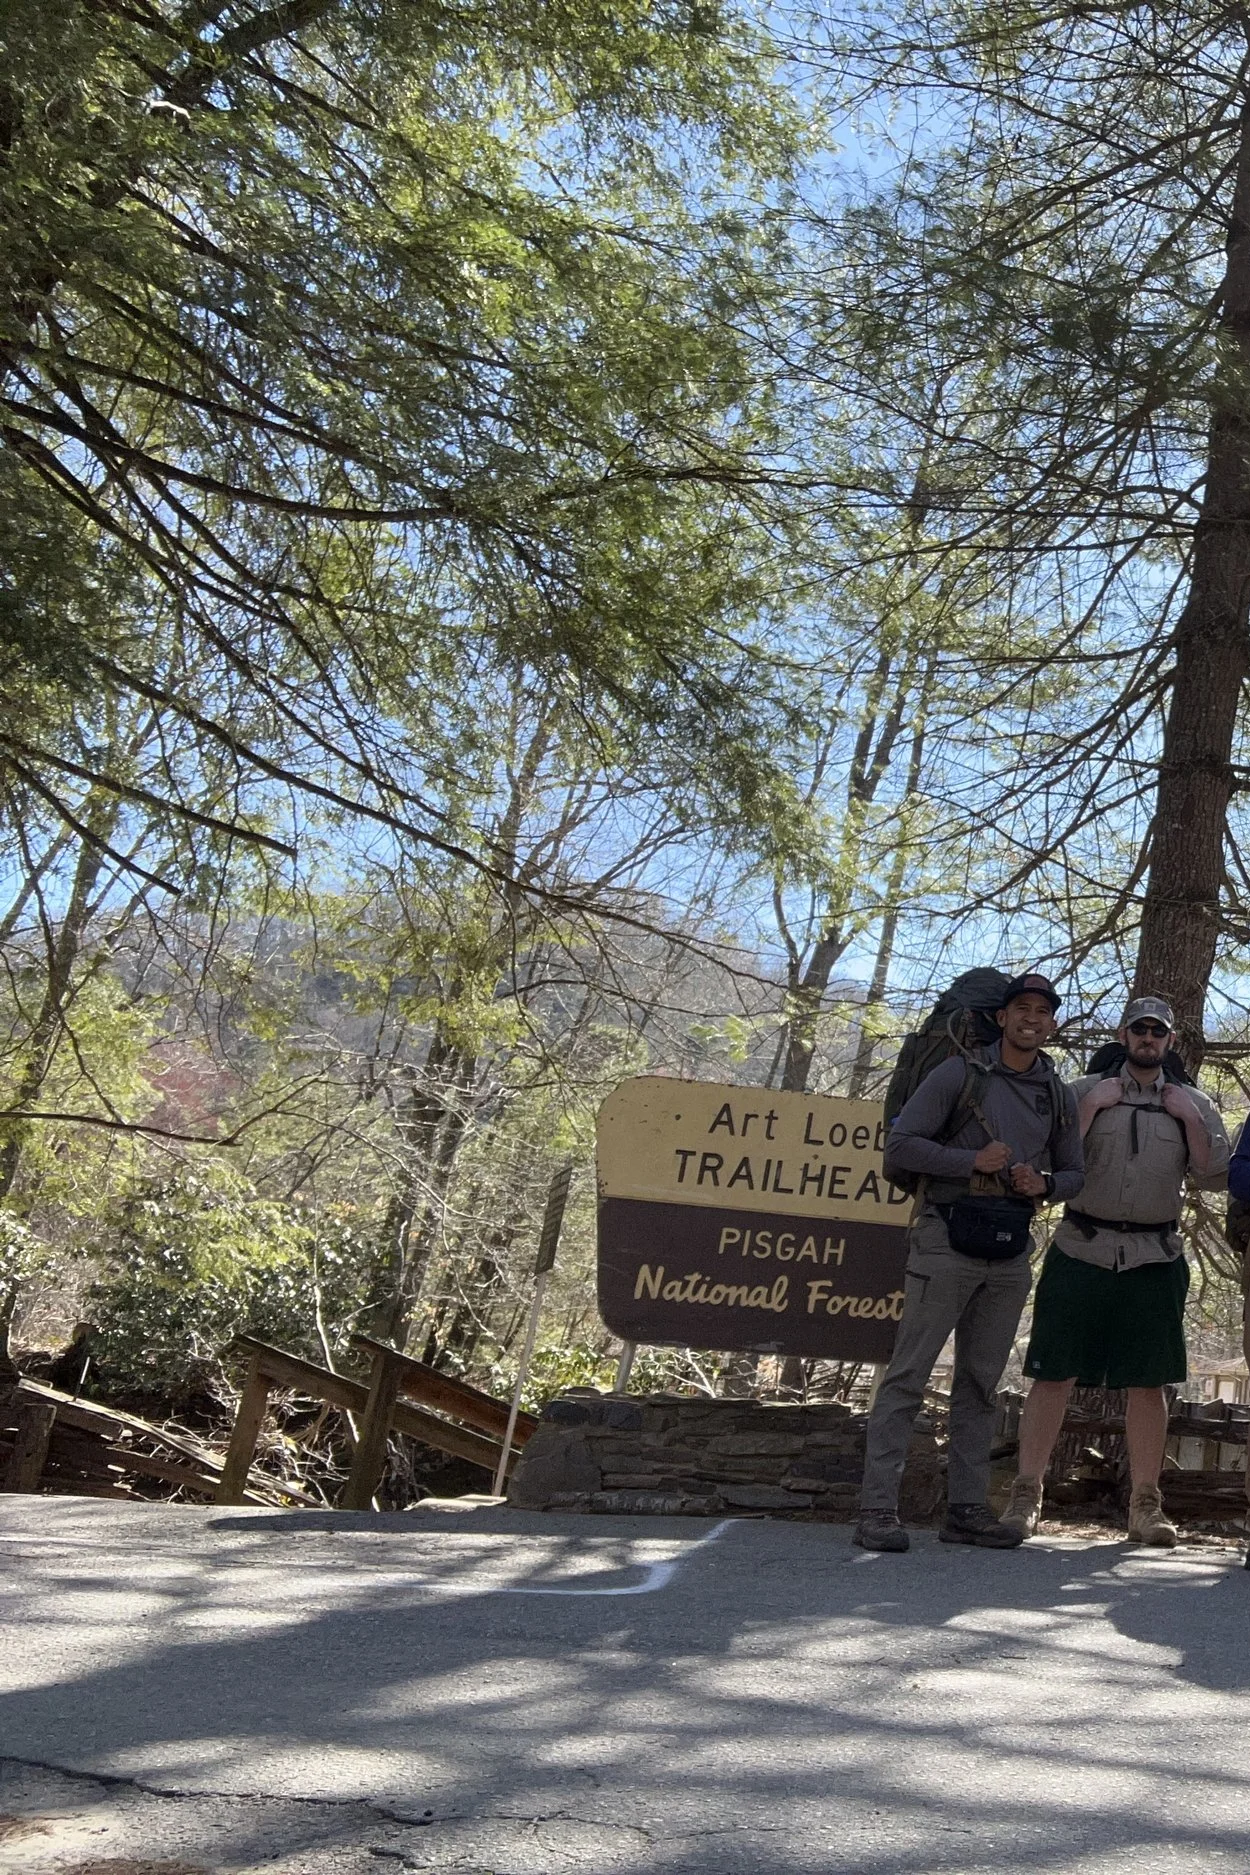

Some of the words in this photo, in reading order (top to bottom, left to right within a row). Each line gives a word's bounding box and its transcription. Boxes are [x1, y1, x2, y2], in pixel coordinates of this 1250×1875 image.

[708, 1103, 779, 1140] Art
[675, 1149, 910, 1205] TRAILHEAD
[718, 1227, 846, 1266] PISGAH
[634, 1264, 789, 1312] National
[806, 1280, 906, 1321] Forest
